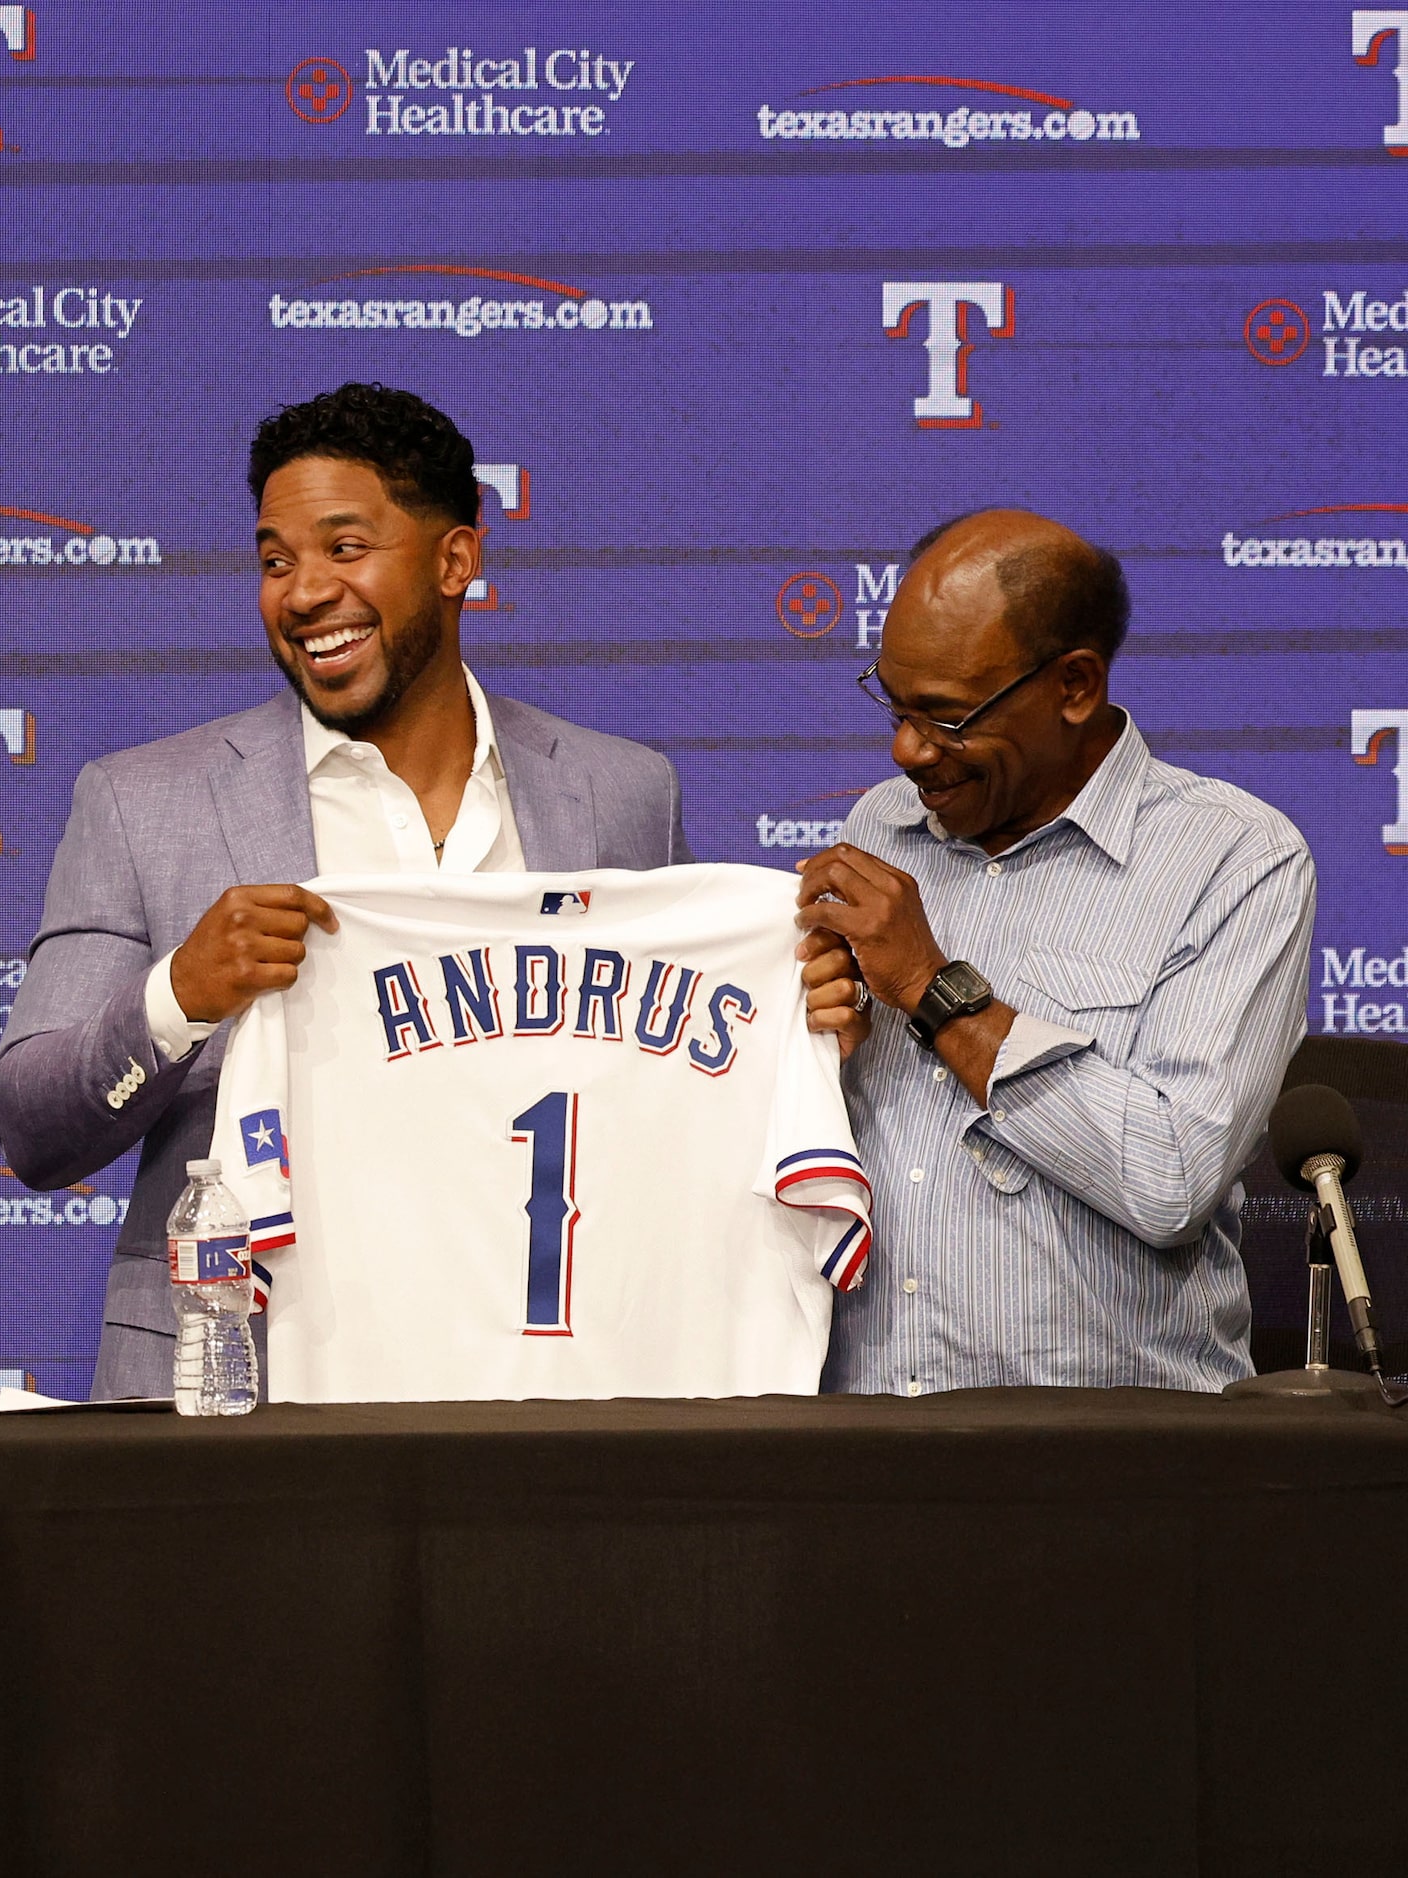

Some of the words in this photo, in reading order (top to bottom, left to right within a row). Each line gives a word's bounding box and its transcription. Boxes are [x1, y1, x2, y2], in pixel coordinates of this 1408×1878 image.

[366, 48, 537, 89] Medical
[546, 50, 634, 100] City
[366, 94, 604, 136] Healthcare
[757, 105, 1140, 147] texasrangers.com
[53, 288, 142, 337] City
[269, 294, 653, 336] texasrangers.com
[883, 282, 1014, 429] T
[373, 944, 757, 1077] ANDRUS
[506, 1091, 581, 1338] 1
